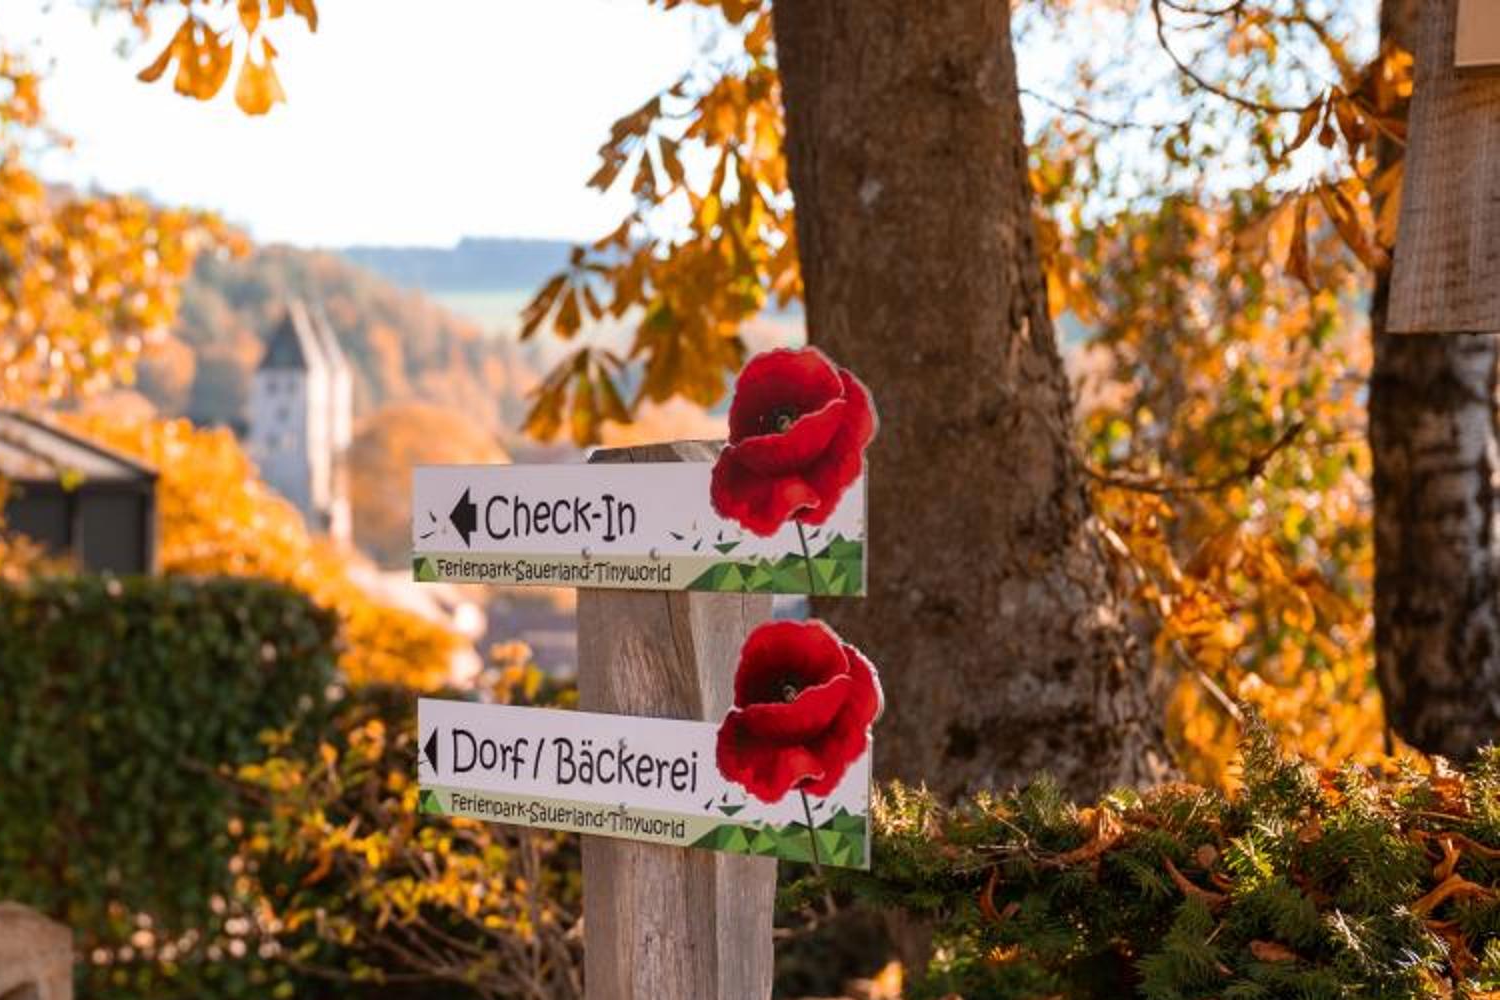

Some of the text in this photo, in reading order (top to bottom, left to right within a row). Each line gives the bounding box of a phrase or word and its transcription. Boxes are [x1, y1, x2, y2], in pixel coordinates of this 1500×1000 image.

[485, 494, 636, 542] Check-In
[436, 559, 672, 583] Ferienpark-Sauerland-Tinyworld
[451, 794, 686, 838] Ferienpark-Sauerland-Tinyworld
